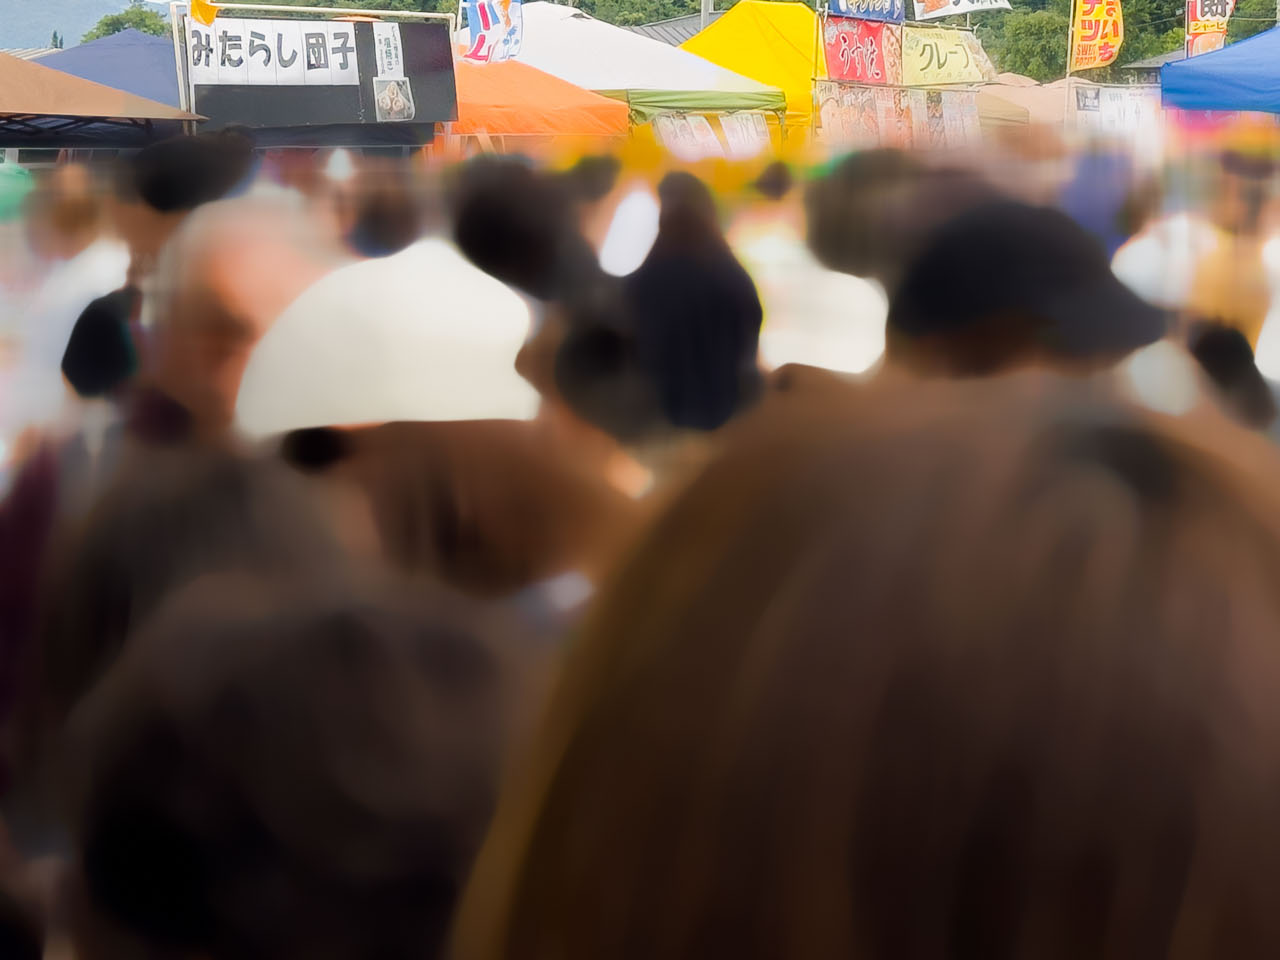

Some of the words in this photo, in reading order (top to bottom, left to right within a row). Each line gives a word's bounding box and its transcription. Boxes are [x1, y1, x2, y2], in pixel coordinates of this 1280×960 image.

[191, 29, 355, 72] みたらし団子
[919, 41, 969, 71] クレープ
